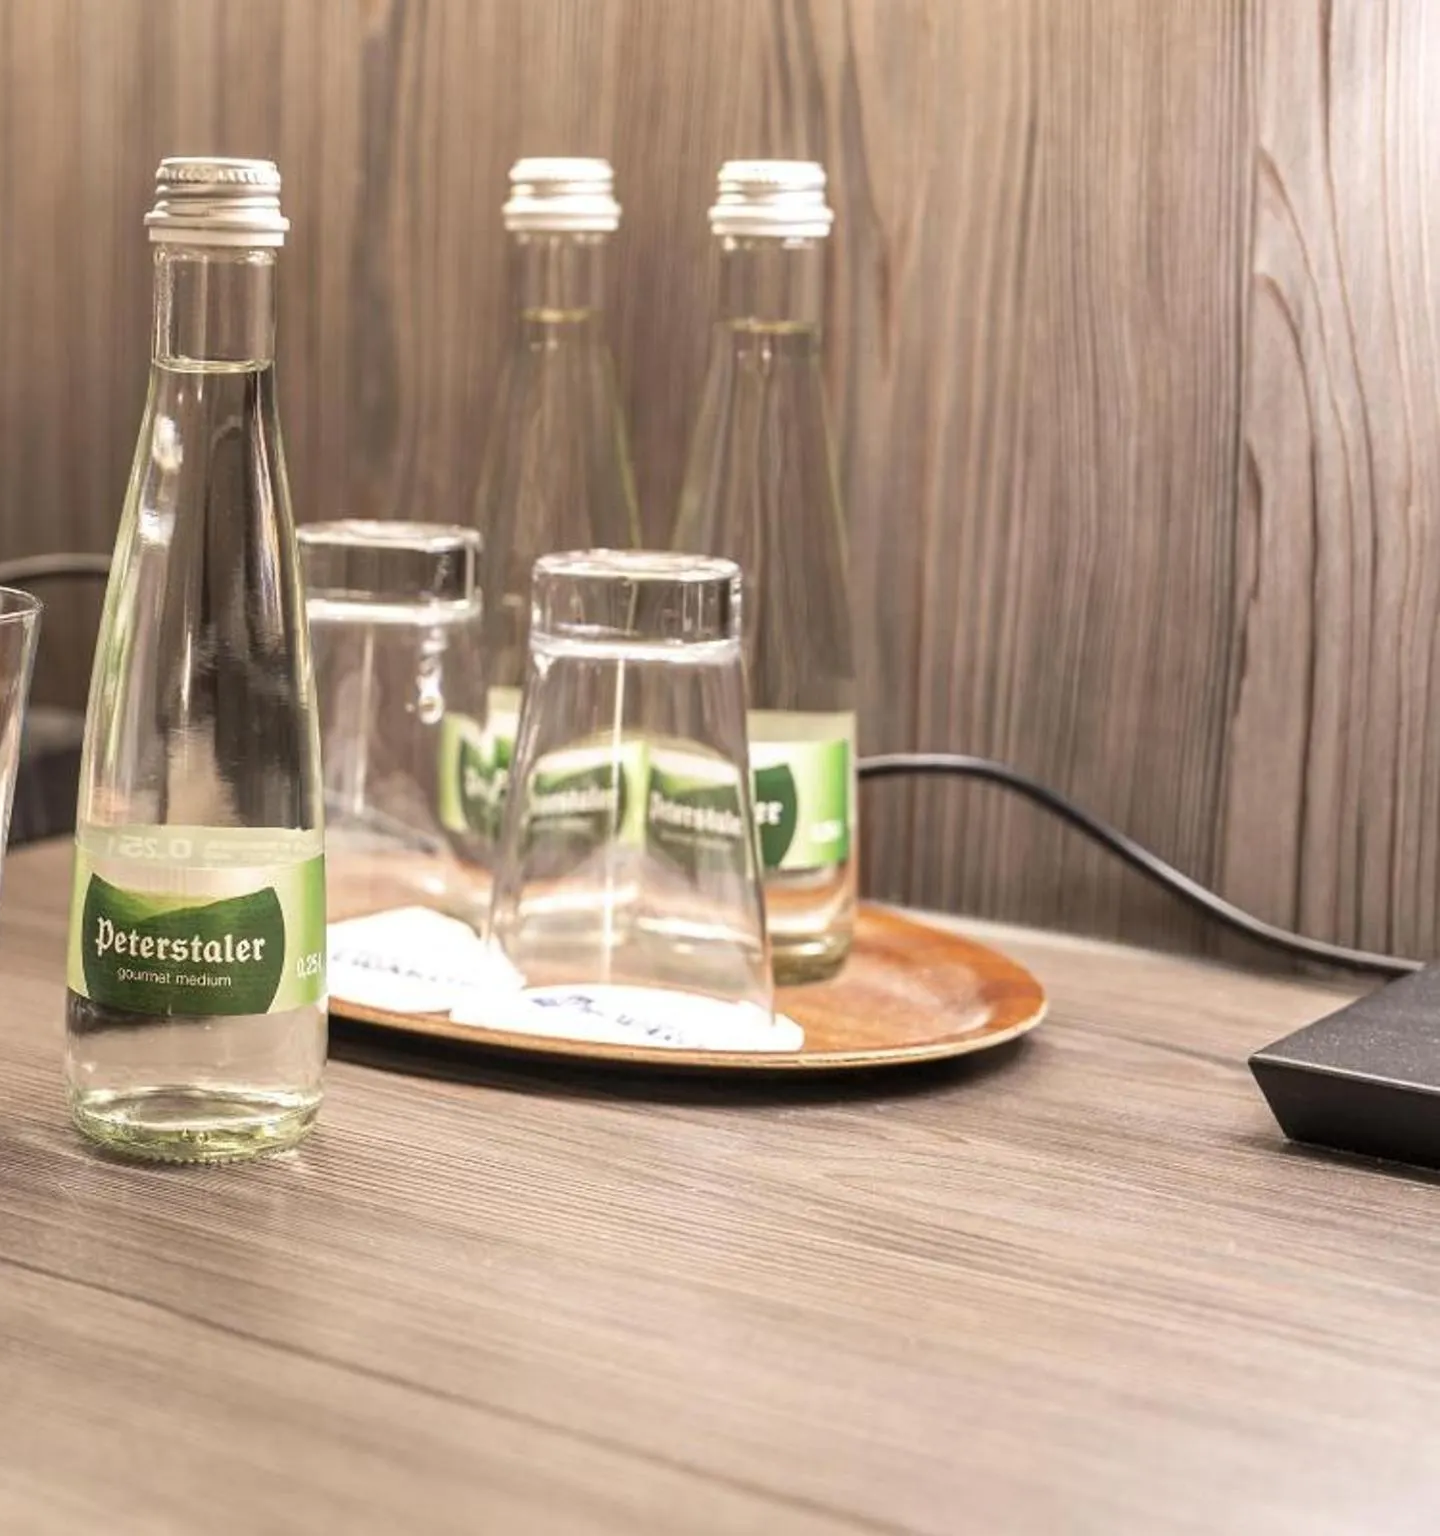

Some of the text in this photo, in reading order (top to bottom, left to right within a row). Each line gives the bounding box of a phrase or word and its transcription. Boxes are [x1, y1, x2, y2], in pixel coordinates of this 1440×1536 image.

[95, 917, 265, 963] Peterstaler
[117, 967, 232, 987] gourmet medium
